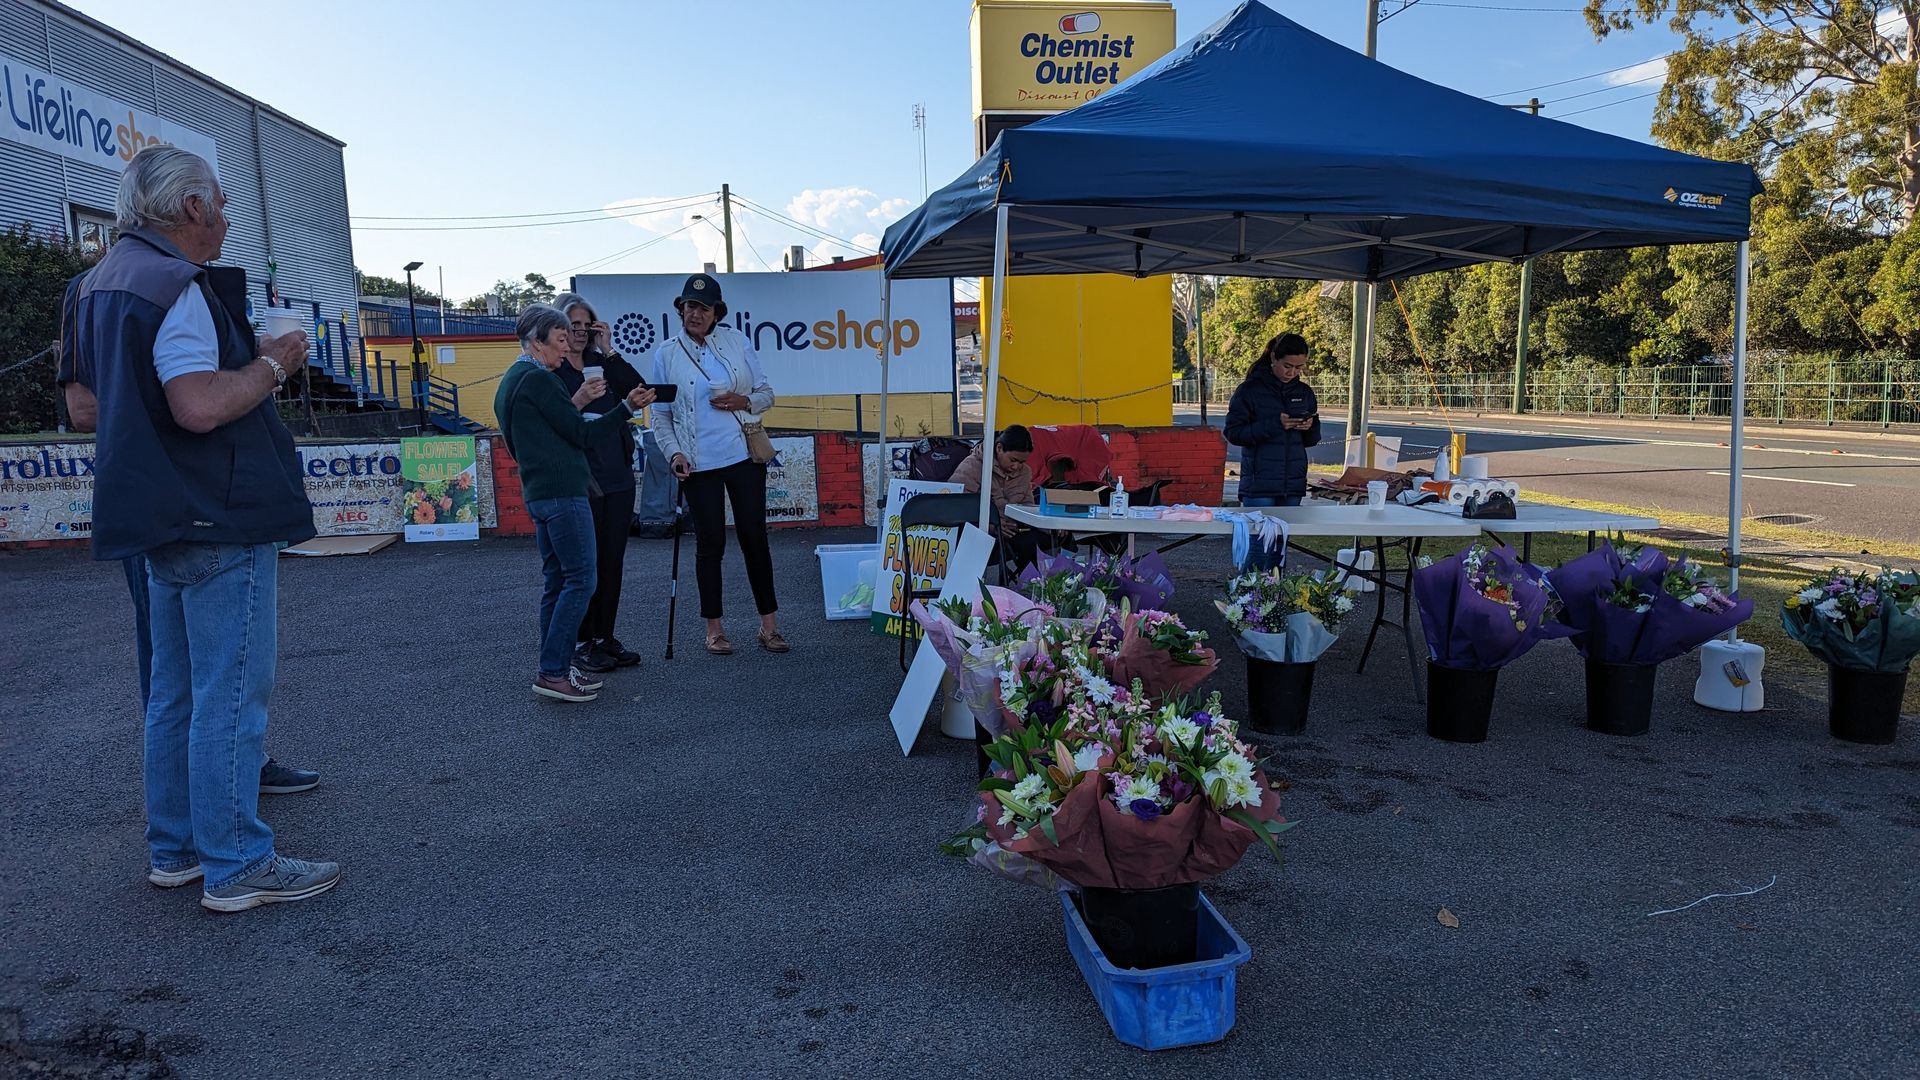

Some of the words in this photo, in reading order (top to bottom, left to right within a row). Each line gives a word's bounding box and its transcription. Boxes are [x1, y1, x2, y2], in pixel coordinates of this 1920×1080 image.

[1020, 33, 1134, 58] Chemist
[1036, 60, 1119, 86] Outlet
[1018, 89, 1079, 101] Discount
[954, 307, 980, 316] DISC
[404, 441, 468, 459] FLOWER
[335, 511, 368, 522] AEG
